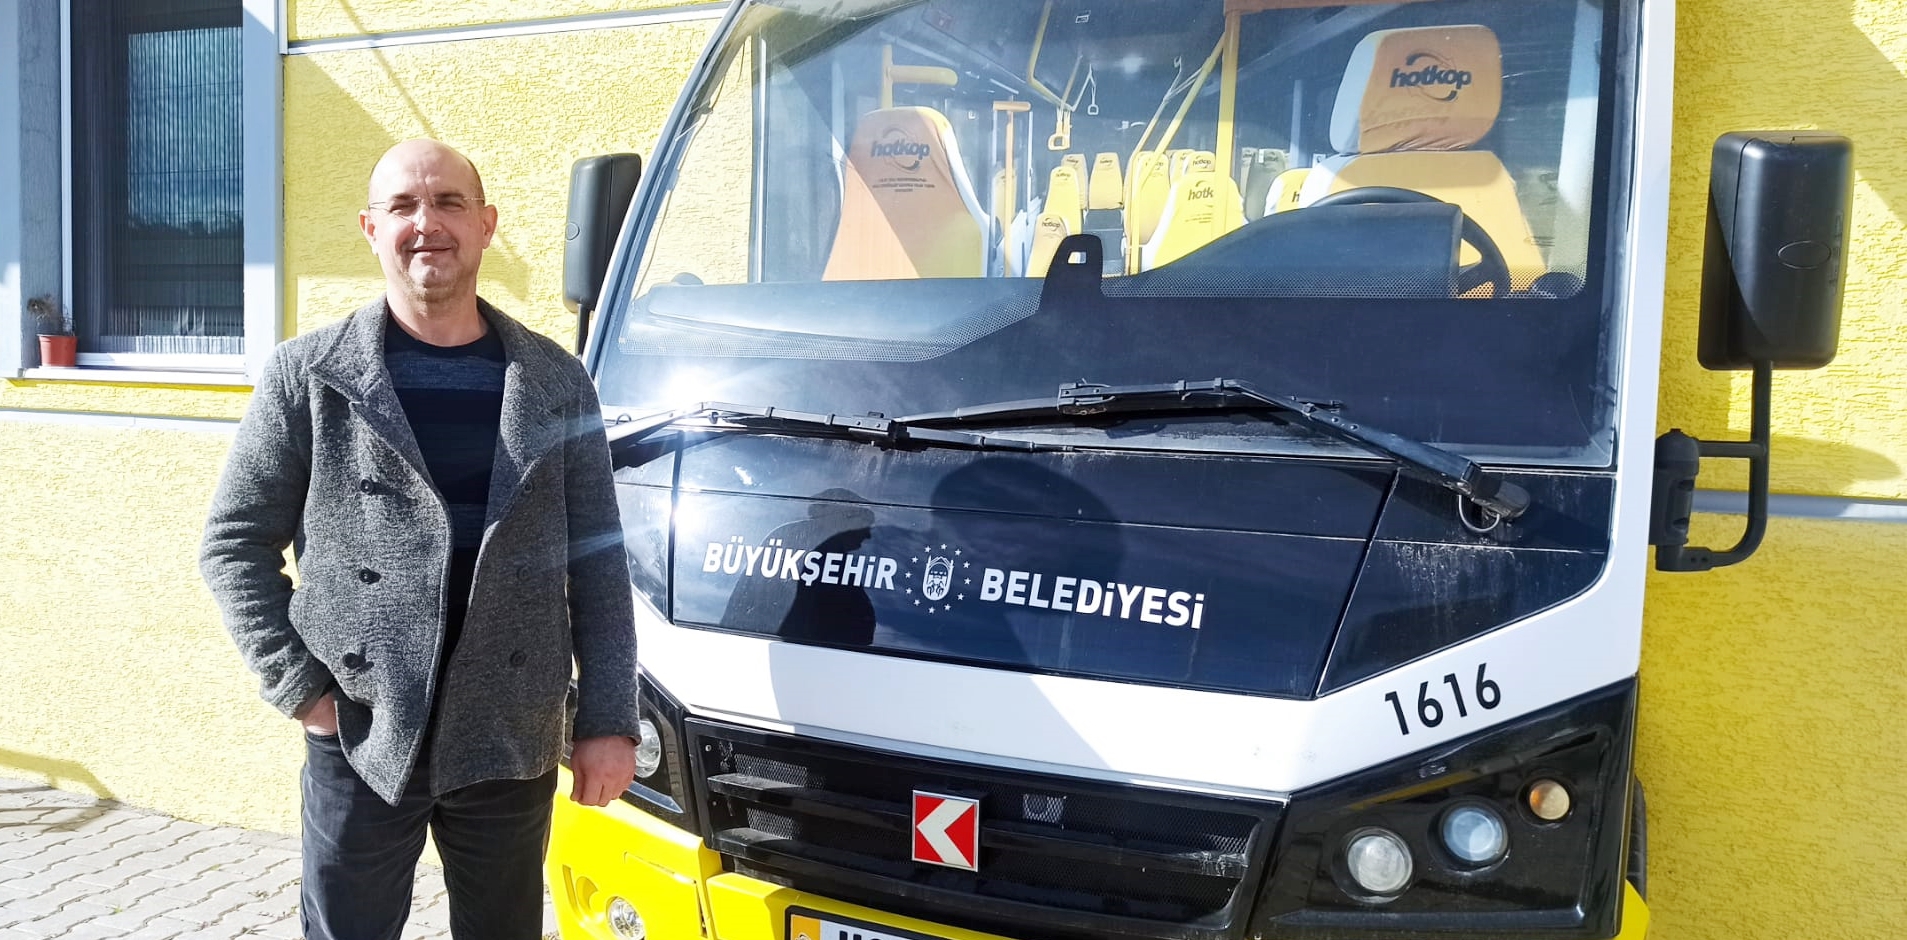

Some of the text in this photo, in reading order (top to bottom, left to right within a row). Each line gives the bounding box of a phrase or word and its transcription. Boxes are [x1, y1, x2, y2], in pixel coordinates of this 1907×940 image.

[1390, 65, 1472, 89] hotkop
[870, 138, 931, 160] hotkop
[1187, 187, 1214, 200] hotk
[1384, 662, 1502, 736] 1616
